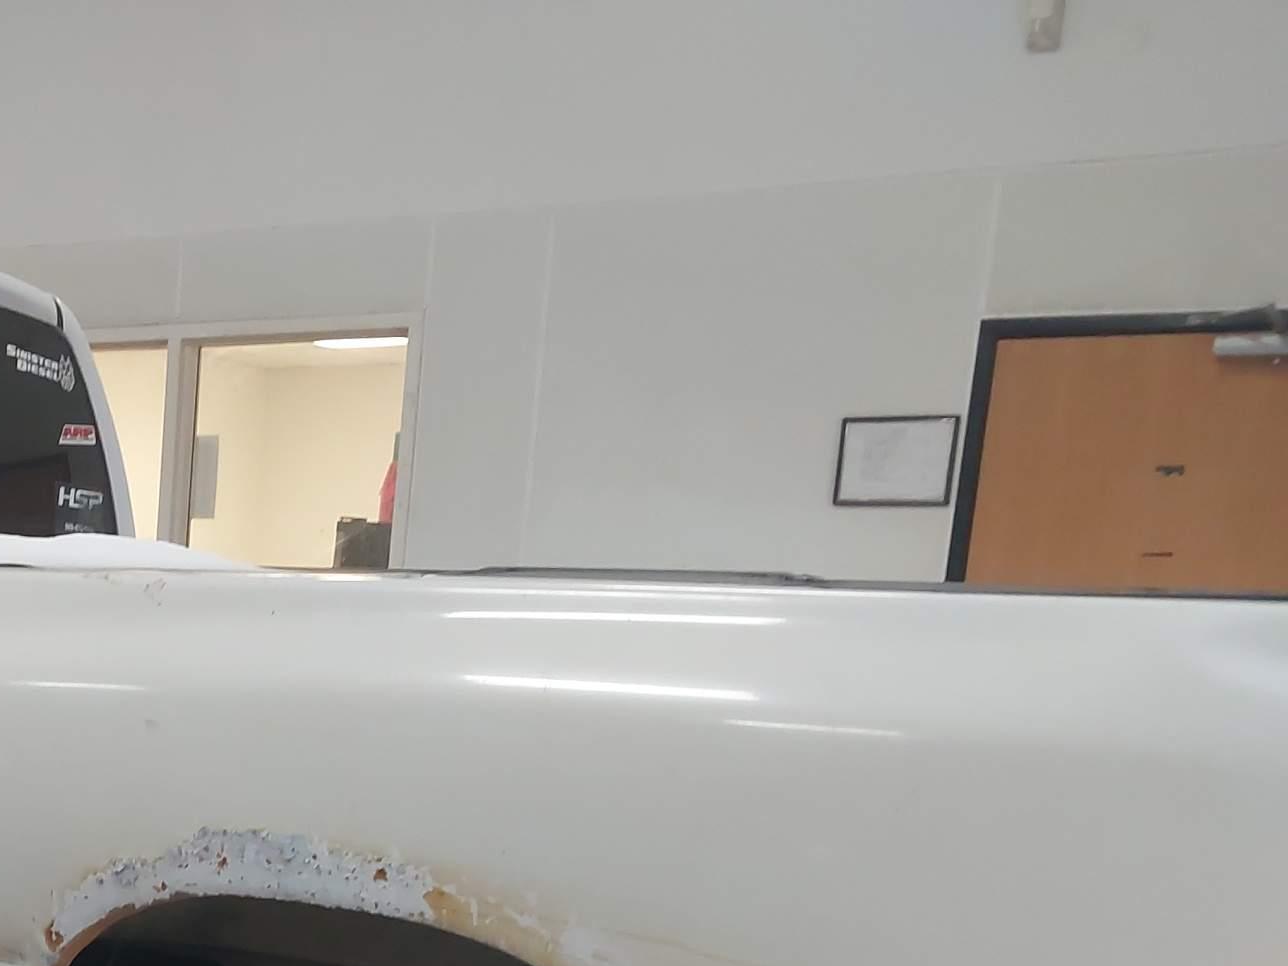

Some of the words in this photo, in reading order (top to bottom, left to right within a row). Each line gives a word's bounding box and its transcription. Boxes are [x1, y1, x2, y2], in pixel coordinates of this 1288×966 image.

[6, 343, 59, 371] SINISTER
[16, 358, 59, 382] DIESEL
[58, 486, 104, 510] HSP
